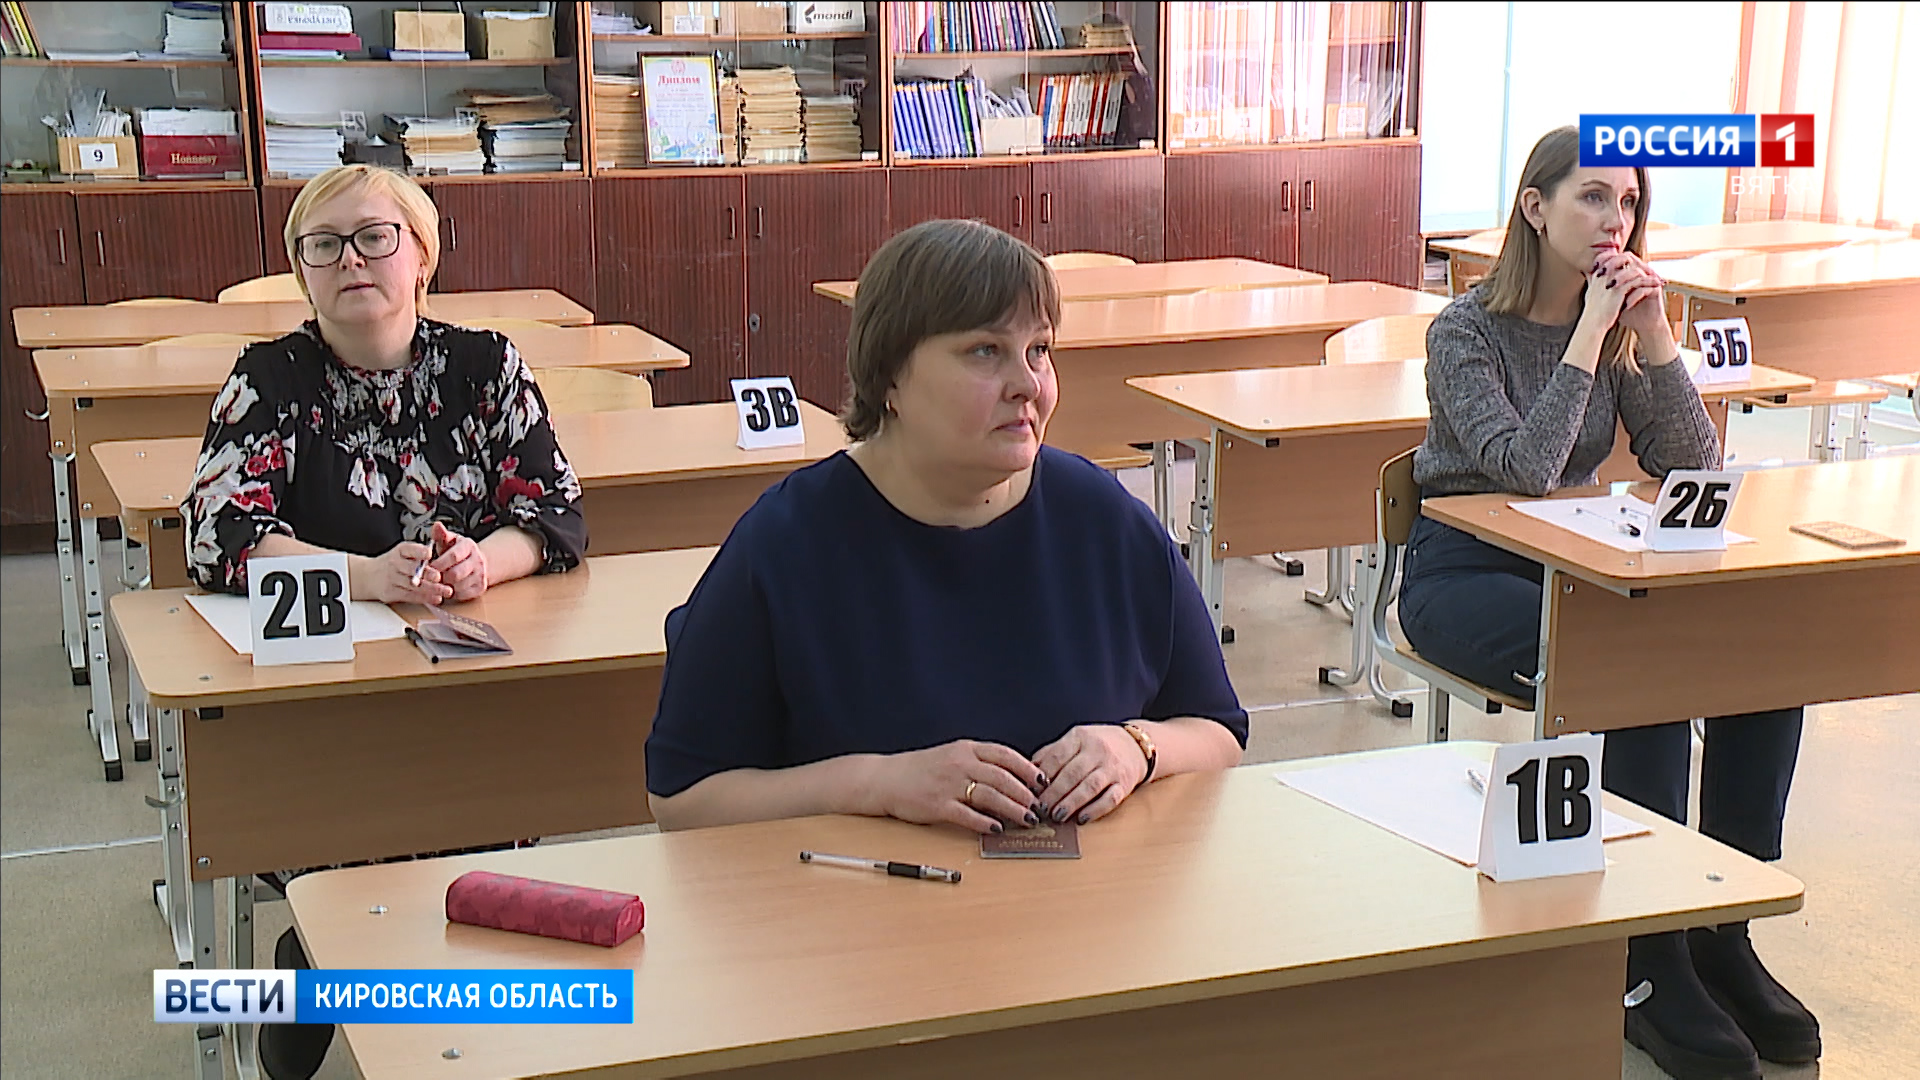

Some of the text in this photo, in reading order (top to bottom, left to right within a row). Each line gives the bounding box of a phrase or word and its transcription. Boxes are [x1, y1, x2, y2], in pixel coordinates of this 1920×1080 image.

[813, 9, 853, 20] mondi
[658, 75, 701, 86] Диплом
[93, 149, 104, 162] 9
[1702, 328, 1747, 368] 3Б
[741, 387, 799, 432] 3В
[1660, 481, 1731, 528] 2Б
[260, 569, 346, 640] 2В
[1506, 755, 1592, 844] 1В
